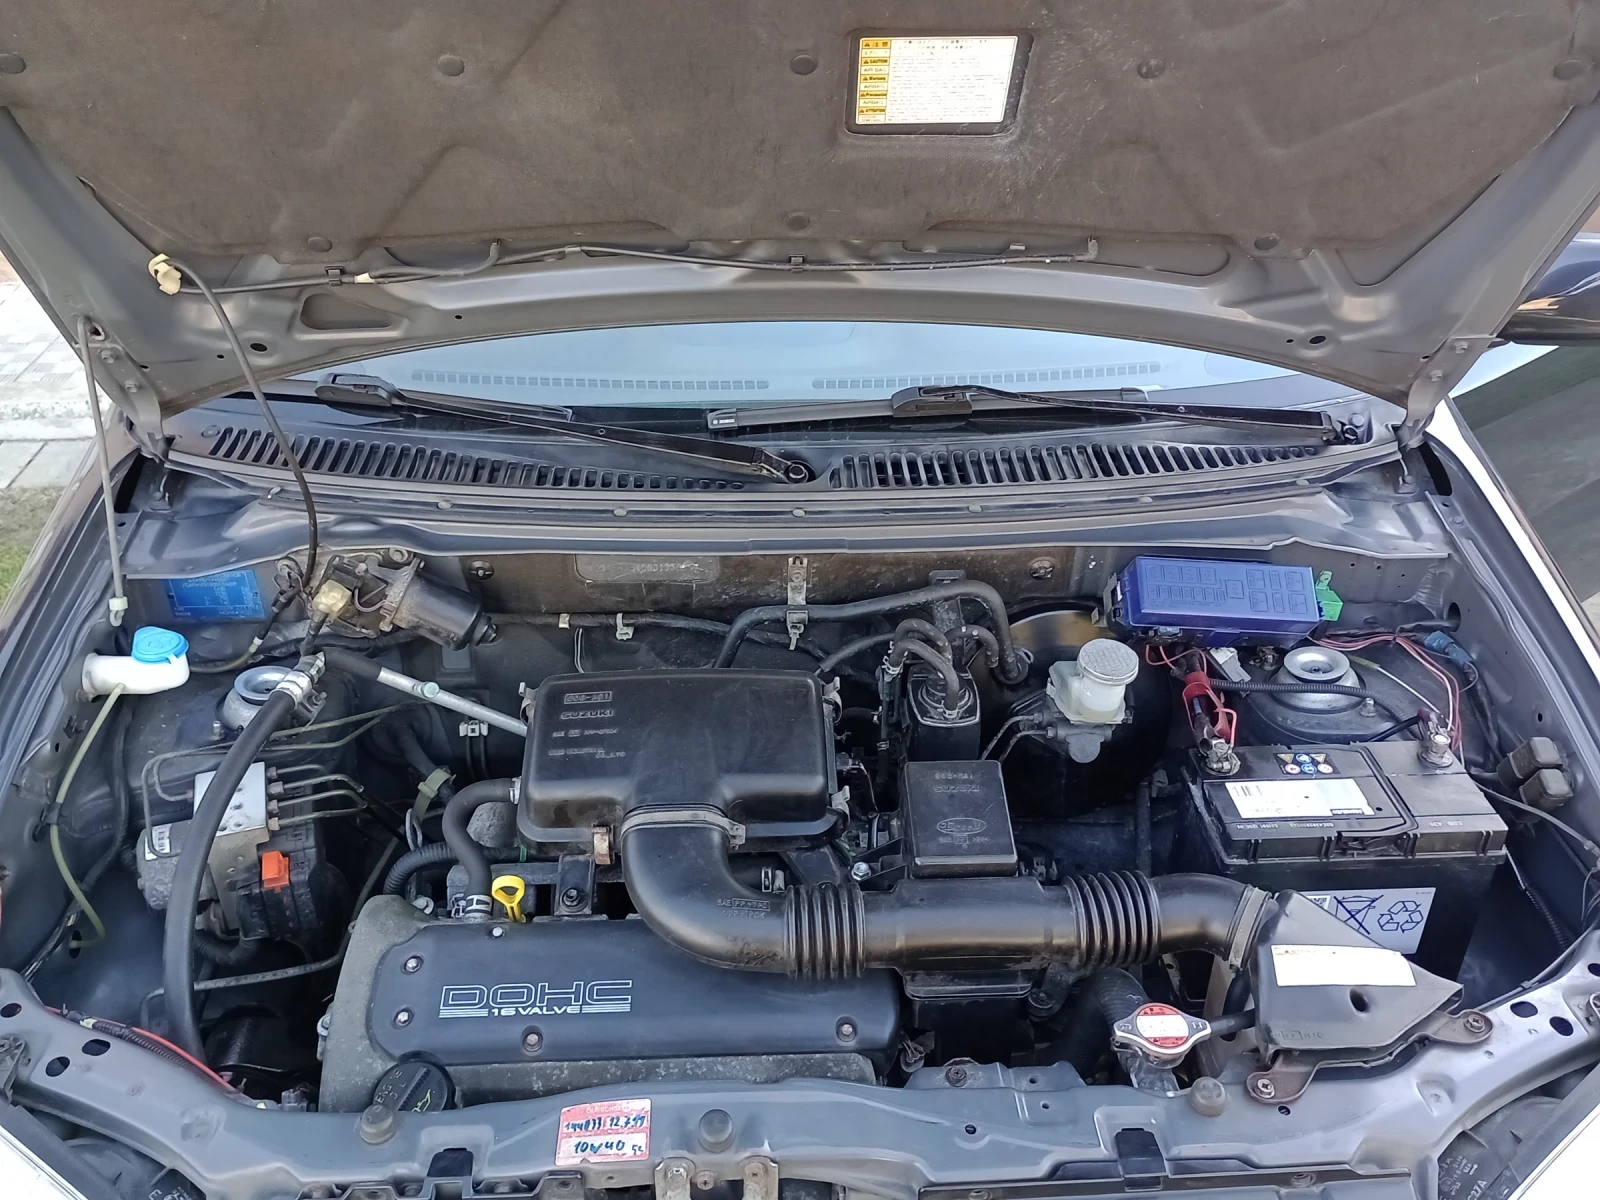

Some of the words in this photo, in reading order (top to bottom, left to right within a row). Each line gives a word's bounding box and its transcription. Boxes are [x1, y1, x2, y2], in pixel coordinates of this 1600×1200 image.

[561, 709, 614, 720] SUZUKI
[934, 784, 980, 793] SUZUKI
[717, 898, 732, 907] SAE
[440, 980, 632, 1009] DOHC
